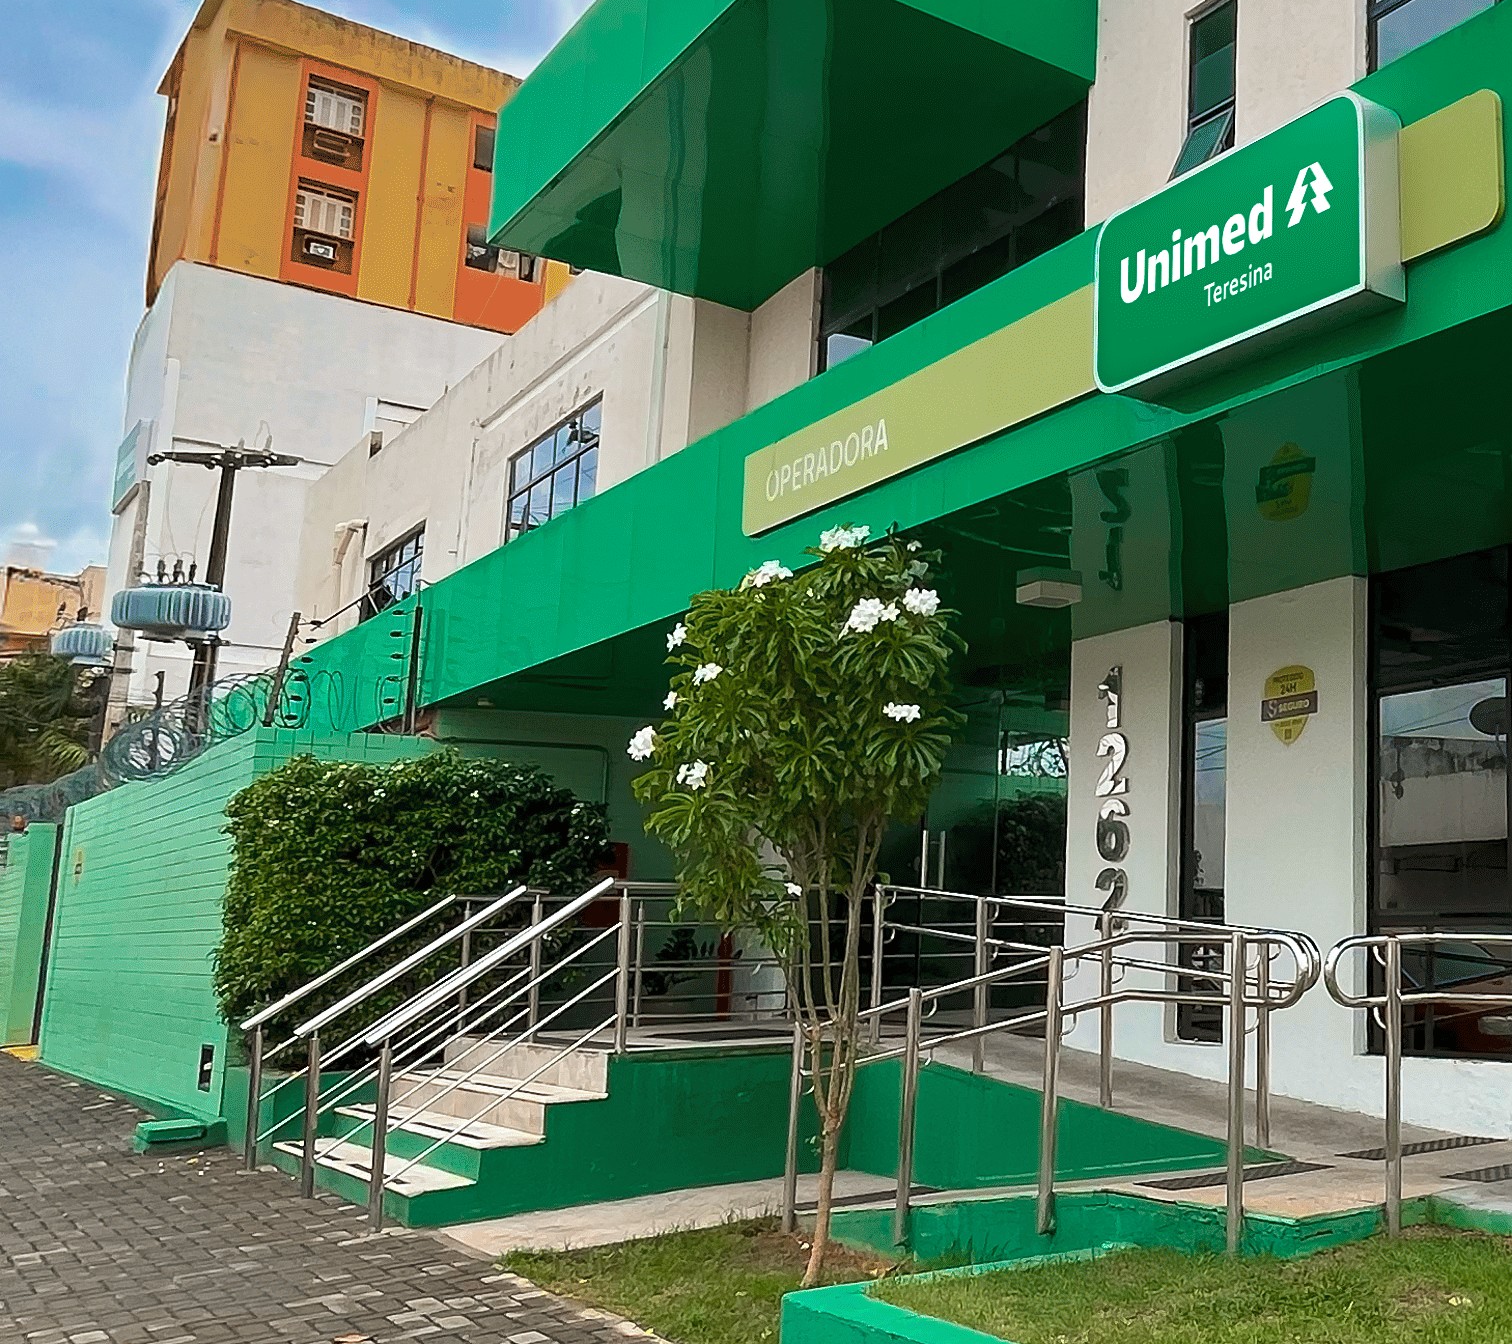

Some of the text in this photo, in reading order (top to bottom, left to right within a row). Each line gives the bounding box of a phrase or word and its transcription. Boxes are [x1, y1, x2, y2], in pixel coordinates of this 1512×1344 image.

[1120, 185, 1274, 304] Unimed
[1204, 262, 1273, 307] Teresina
[767, 419, 888, 502] OPERADORA
[1095, 665, 1131, 932] 1262
